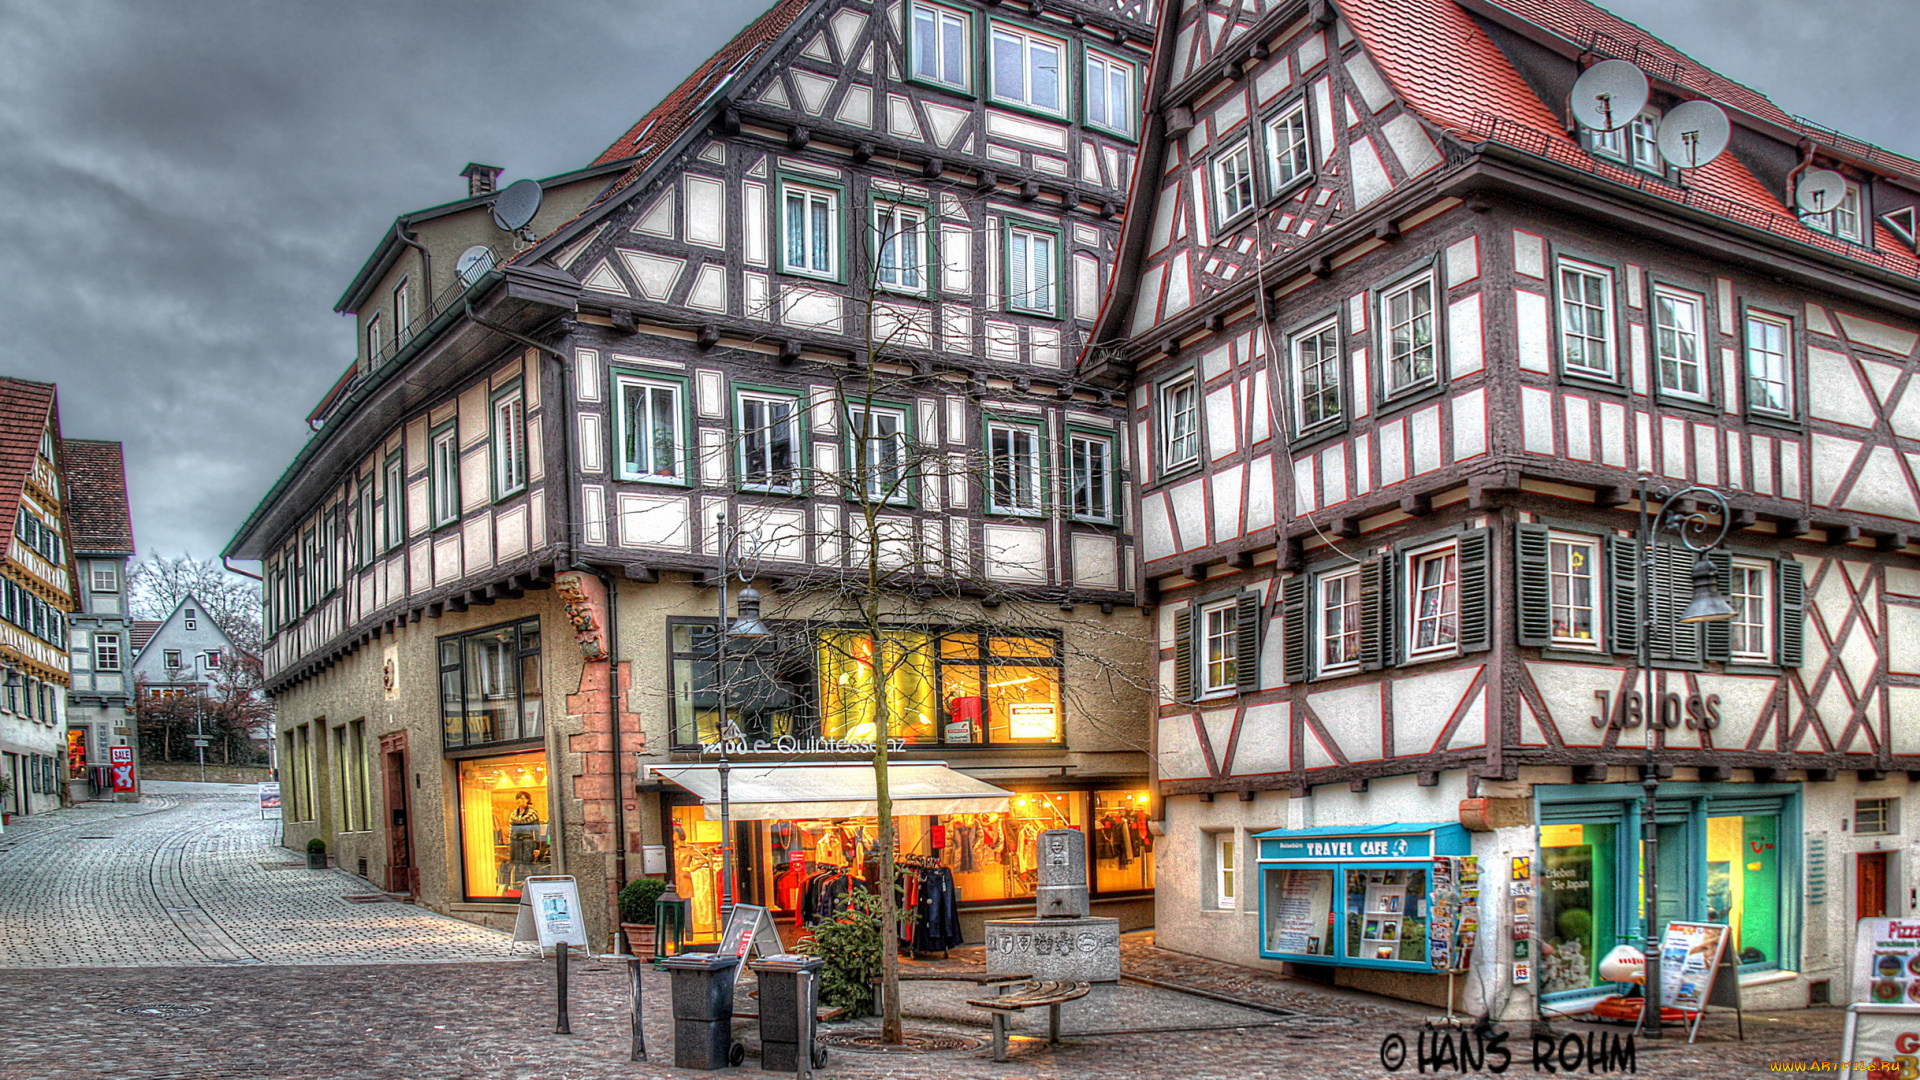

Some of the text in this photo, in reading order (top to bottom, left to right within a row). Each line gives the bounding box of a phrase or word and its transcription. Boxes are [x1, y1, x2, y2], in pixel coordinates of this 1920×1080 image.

[114, 750, 130, 760] SALE
[1307, 842, 1354, 856] TRAVEL
[1360, 841, 1388, 855] CAFE
[1552, 880, 1590, 891] Sie Japan
[1516, 968, 1528, 976] ITS
